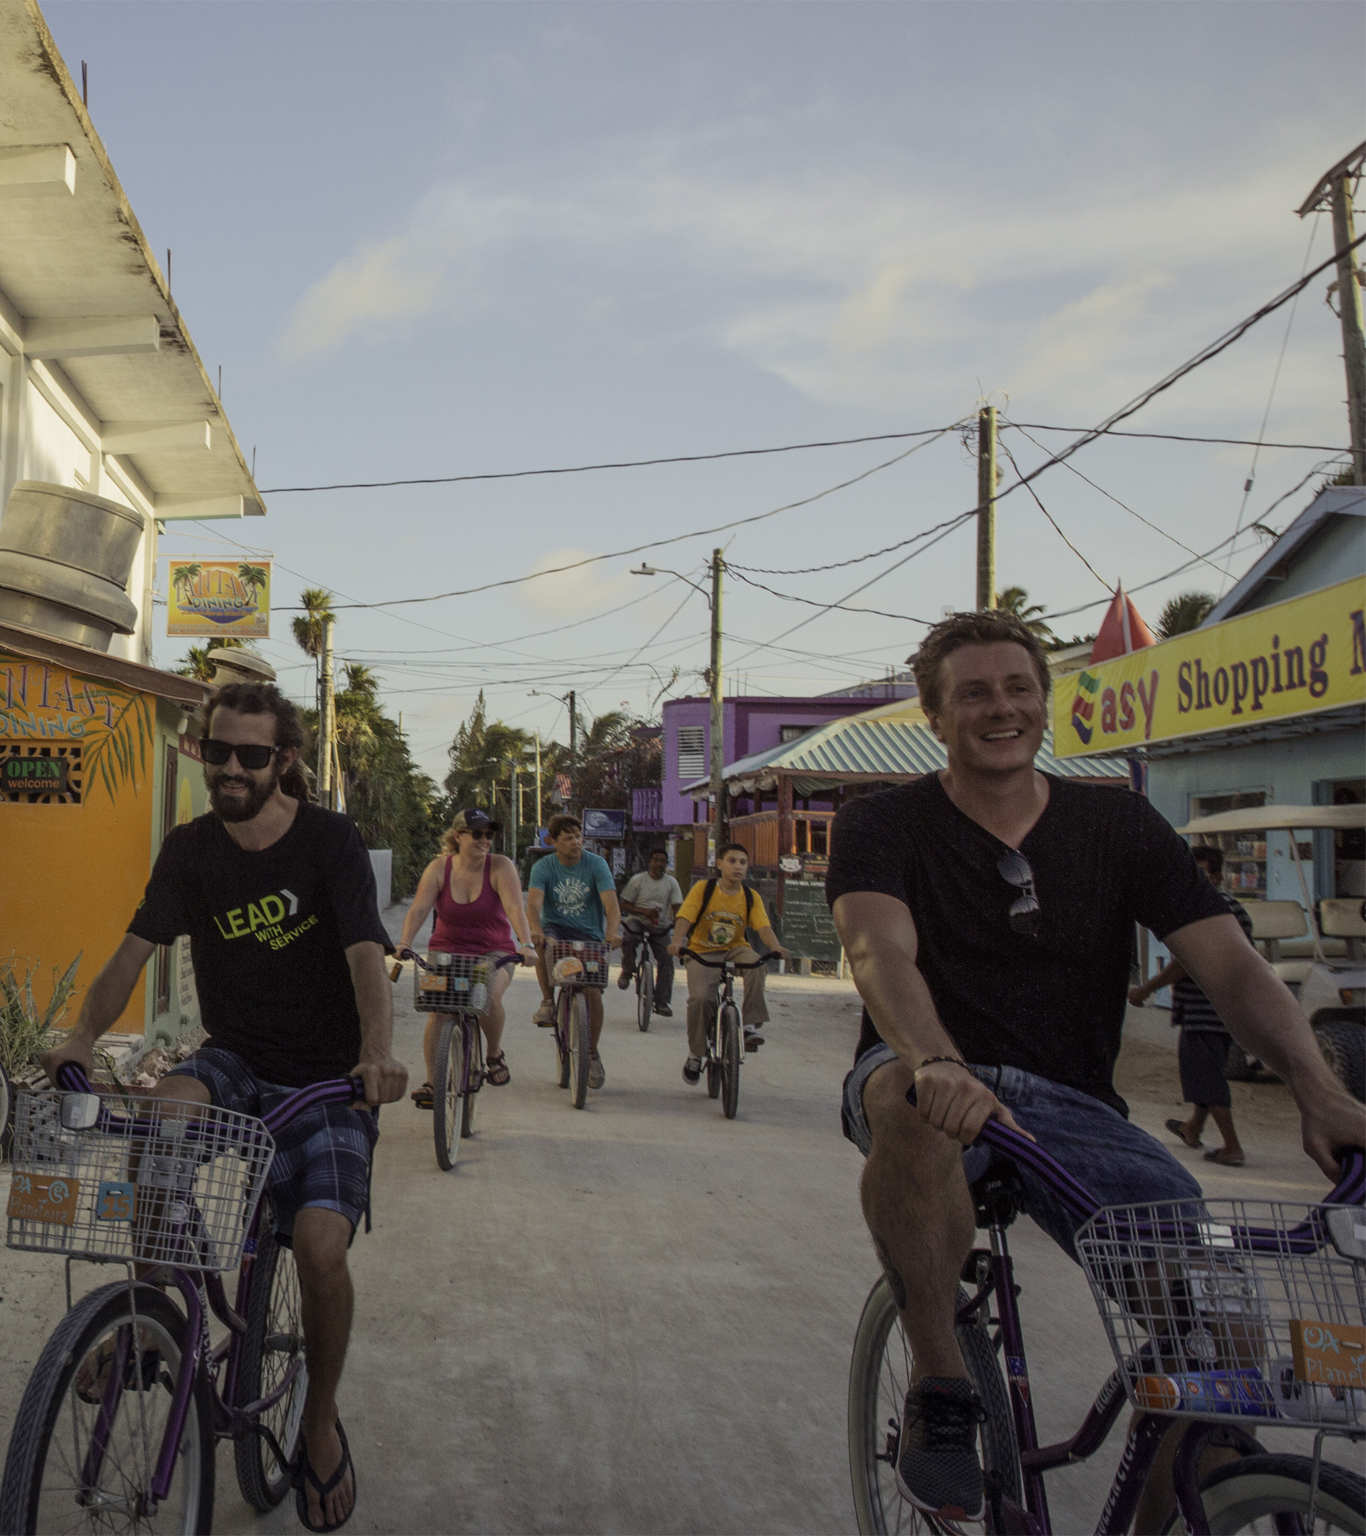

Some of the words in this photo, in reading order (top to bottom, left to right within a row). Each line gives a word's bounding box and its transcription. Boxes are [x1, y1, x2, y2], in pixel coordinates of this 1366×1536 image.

[192, 596, 245, 610] DINING
[1177, 633, 1329, 715] Shopping
[6, 760, 62, 779] OPEN
[7, 779, 60, 790] welcome
[213, 894, 286, 940] LEAD
[254, 924, 283, 943] WITH
[269, 913, 320, 951] SERVICE
[100, 1195, 131, 1218] 25
[1303, 1326, 1340, 1354] OA
